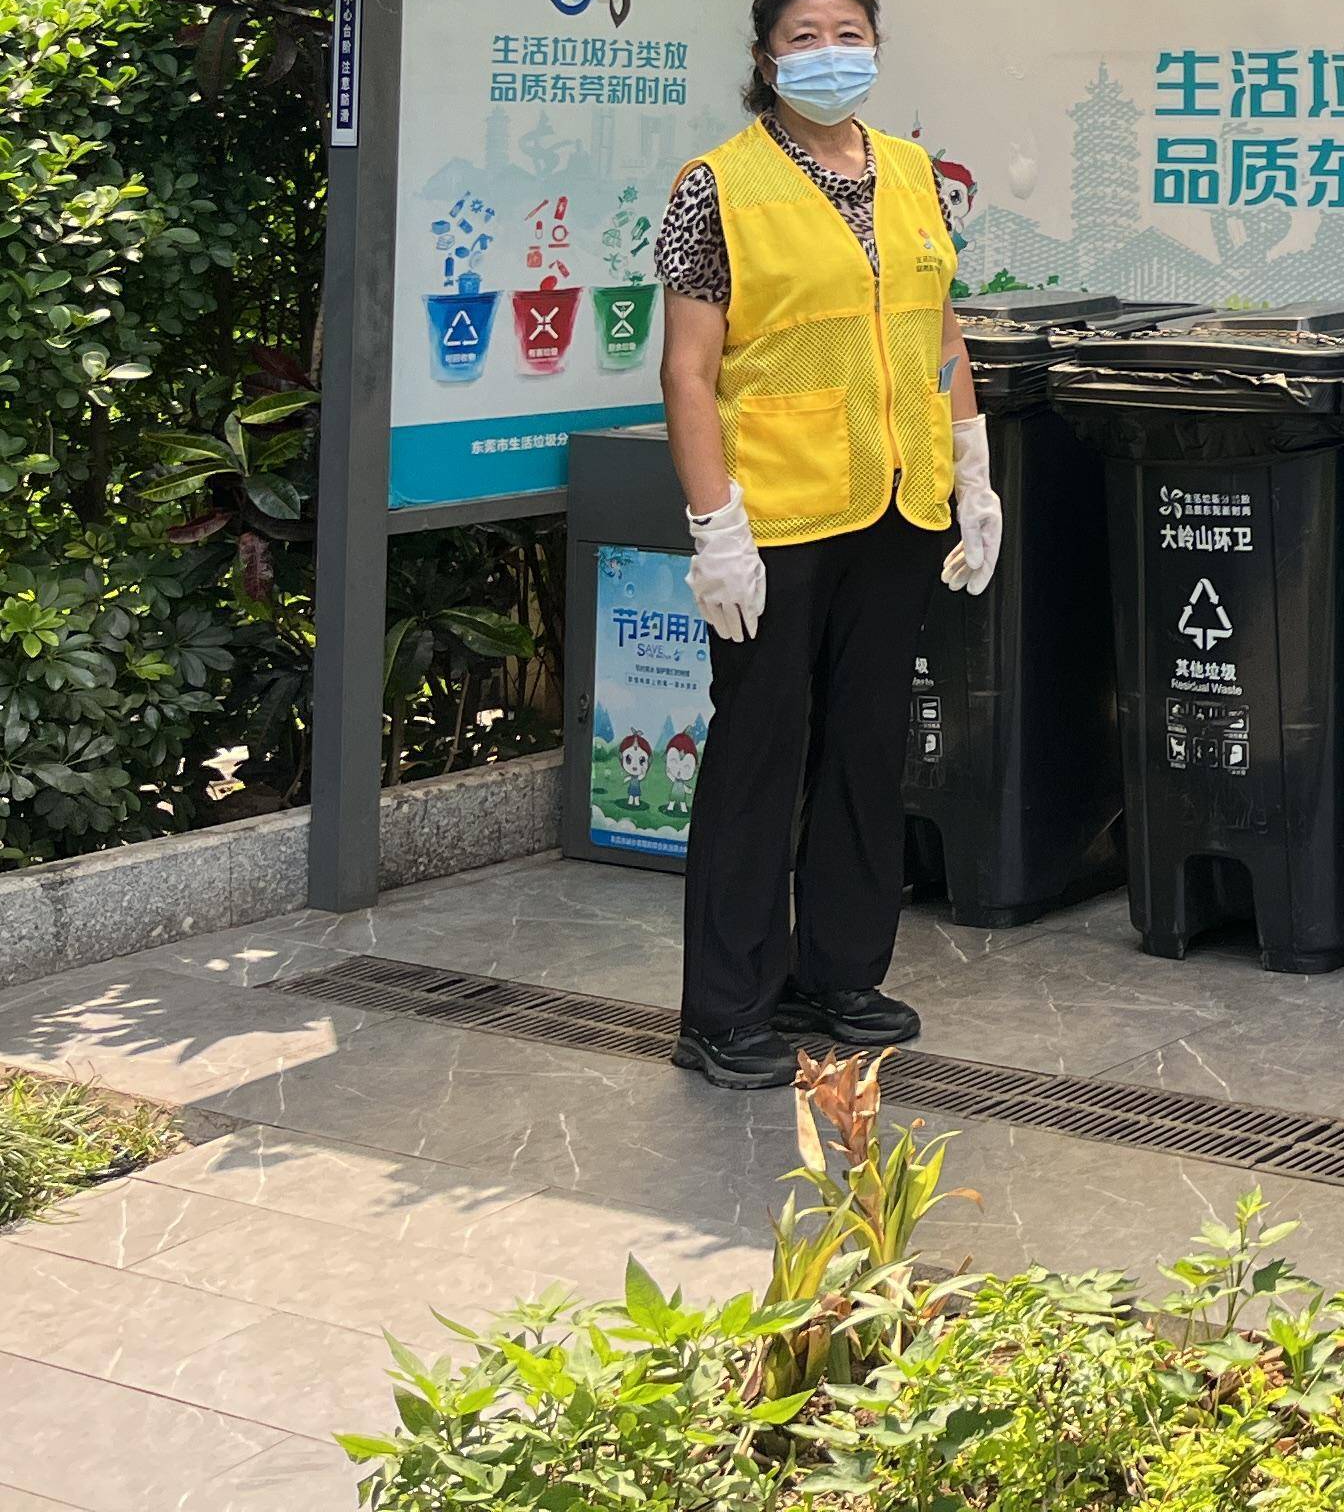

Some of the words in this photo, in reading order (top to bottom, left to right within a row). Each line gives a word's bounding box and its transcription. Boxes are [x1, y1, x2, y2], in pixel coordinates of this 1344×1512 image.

[491, 34, 688, 70] 生活垃圾分类放
[490, 73, 687, 106] 品质东莞新时尚
[1160, 524, 1253, 552] 大岭山环卫
[1175, 659, 1237, 682] 其他垃圾
